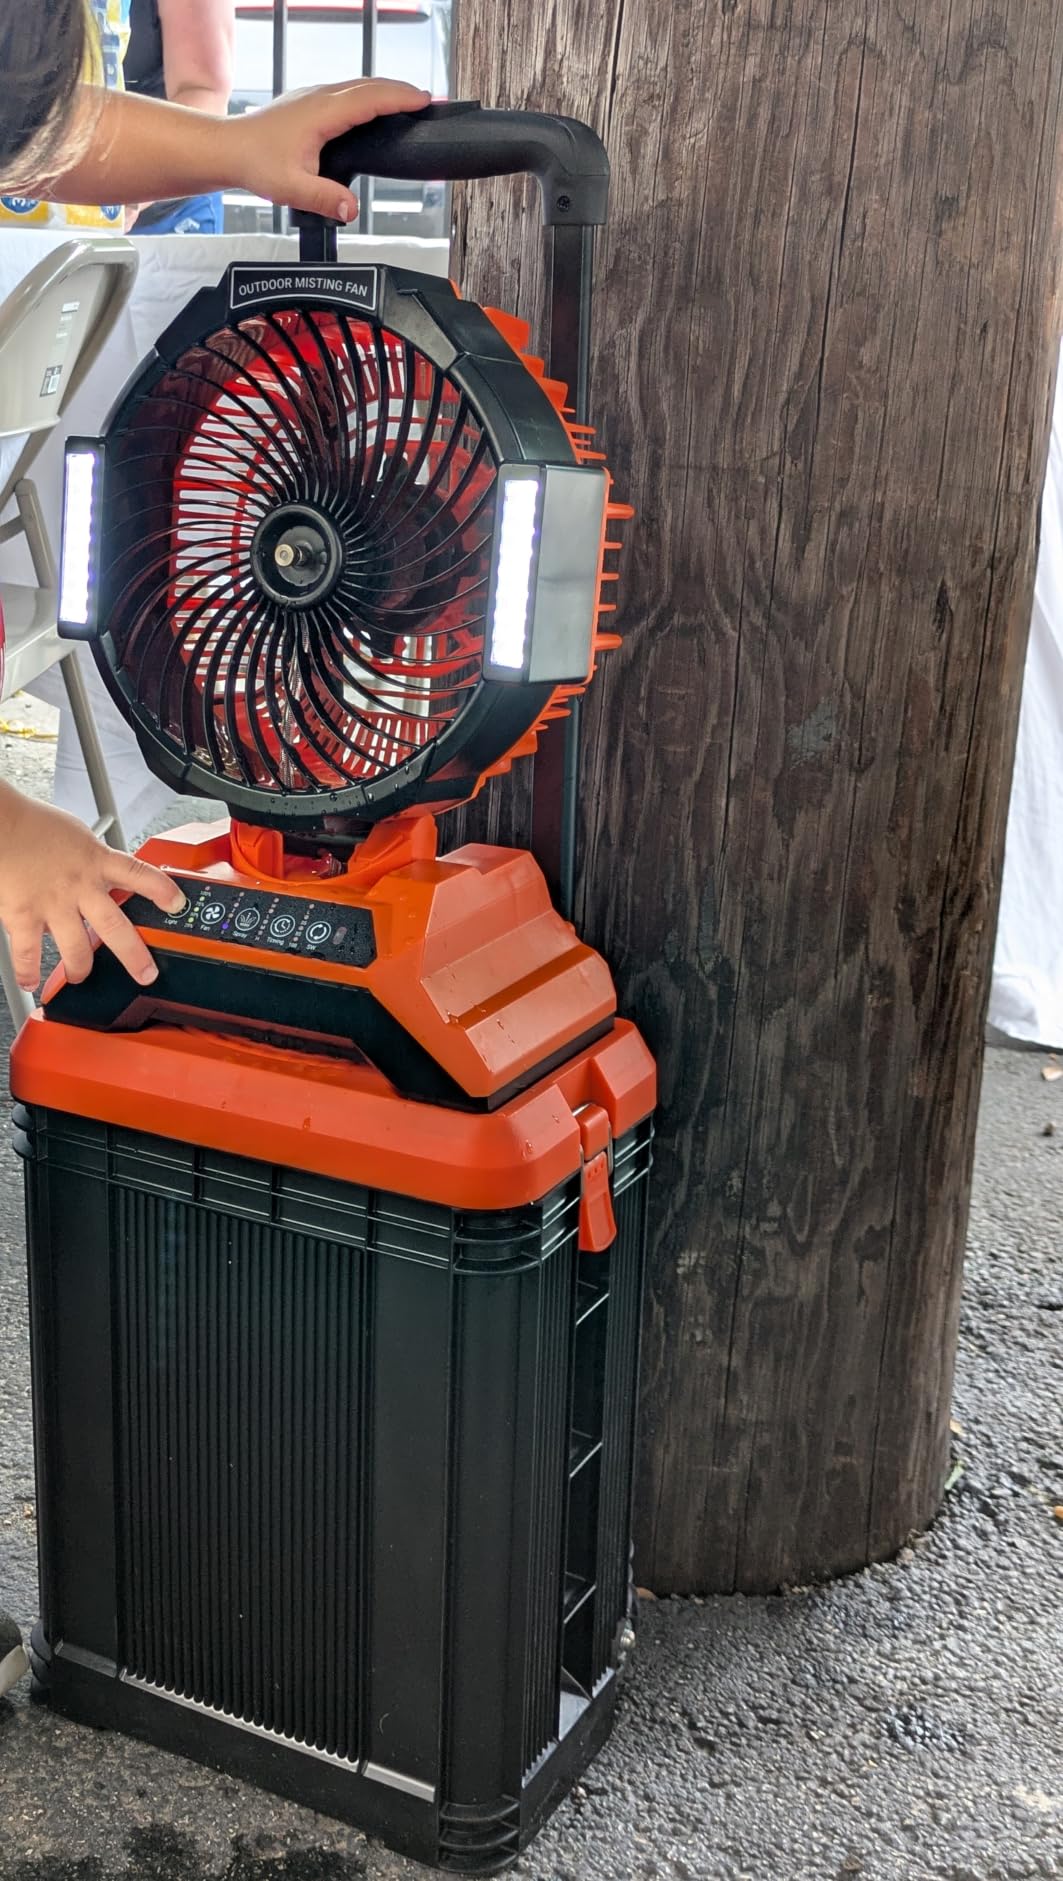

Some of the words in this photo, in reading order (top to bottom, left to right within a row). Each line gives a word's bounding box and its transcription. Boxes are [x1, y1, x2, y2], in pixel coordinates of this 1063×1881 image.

[238, 278, 292, 296] OUTDOOR
[295, 277, 343, 292] MISTING
[345, 282, 368, 297] FAN
[232, 930, 248, 939] Spray
[267, 936, 285, 946] Timing
